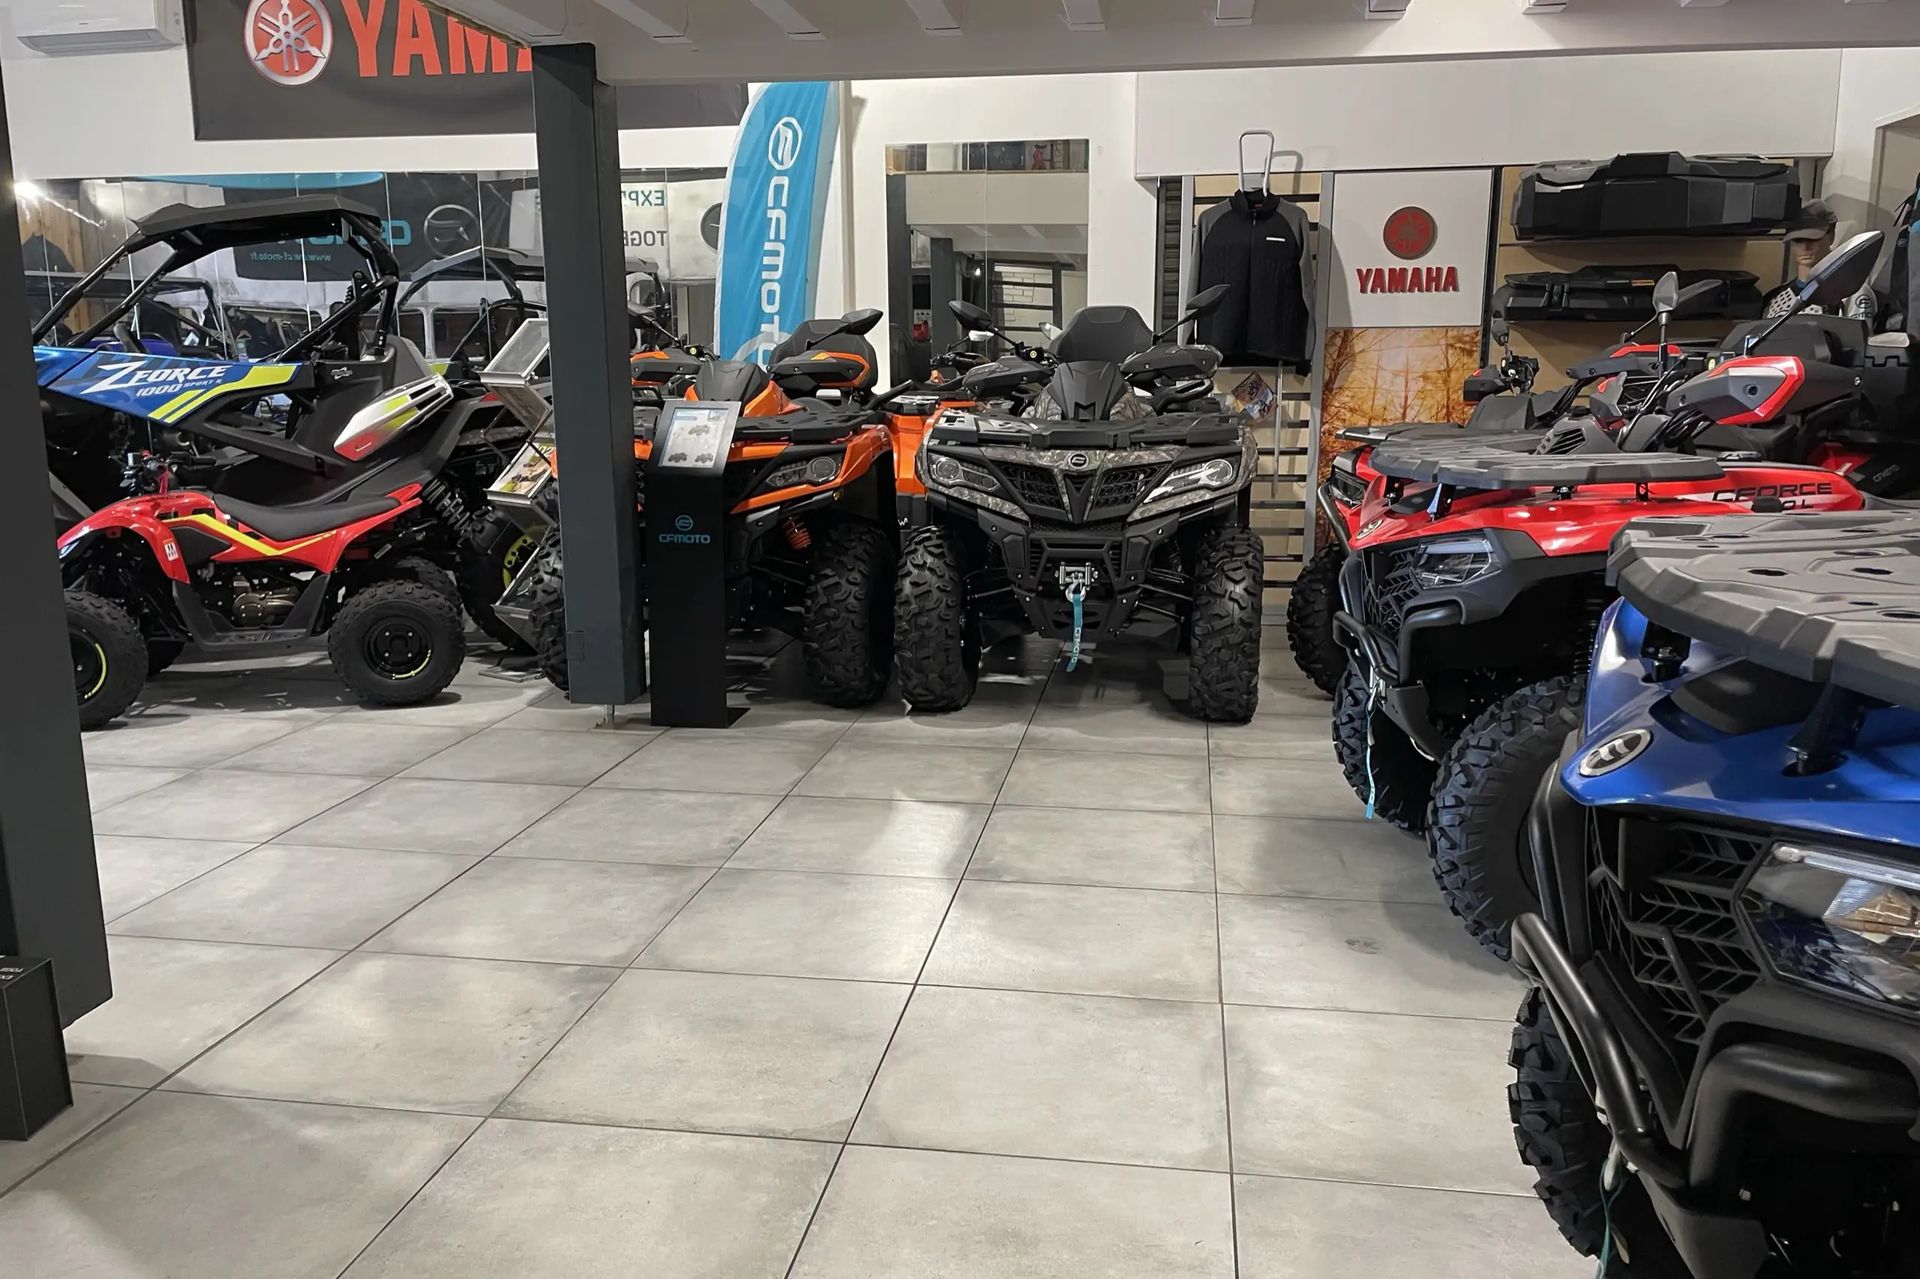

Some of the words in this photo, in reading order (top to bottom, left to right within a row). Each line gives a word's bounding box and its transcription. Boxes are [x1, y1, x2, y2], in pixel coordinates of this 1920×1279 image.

[341, 0, 533, 77] YAM
[1356, 266, 1460, 294] YAMAHA
[136, 383, 184, 397] 1000
[1712, 483, 1832, 501] CFORCE
[659, 534, 711, 544] CFMOTO
[1071, 627, 1081, 663] CFMOTO
